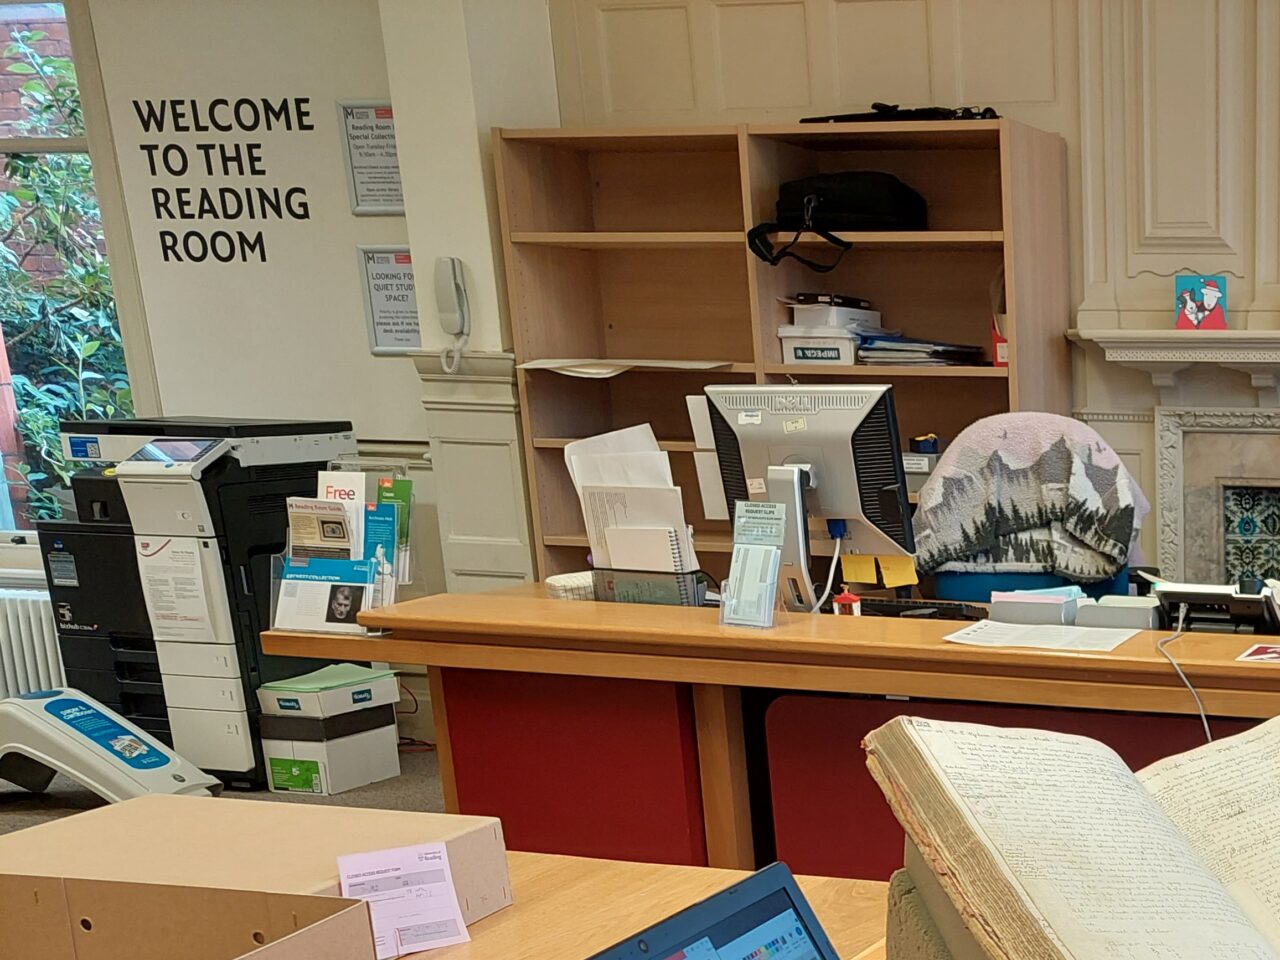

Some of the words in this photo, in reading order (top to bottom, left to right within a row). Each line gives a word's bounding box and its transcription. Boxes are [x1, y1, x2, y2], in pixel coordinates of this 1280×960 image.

[132, 97, 315, 133] WELCOME
[349, 133, 370, 141] Special
[139, 143, 189, 177] TO
[196, 143, 266, 176] THE
[151, 187, 310, 220] READING
[159, 230, 267, 263] ROOM
[374, 283, 394, 292] QUIET
[385, 294, 409, 302] SPACE?
[326, 485, 355, 500] Free
